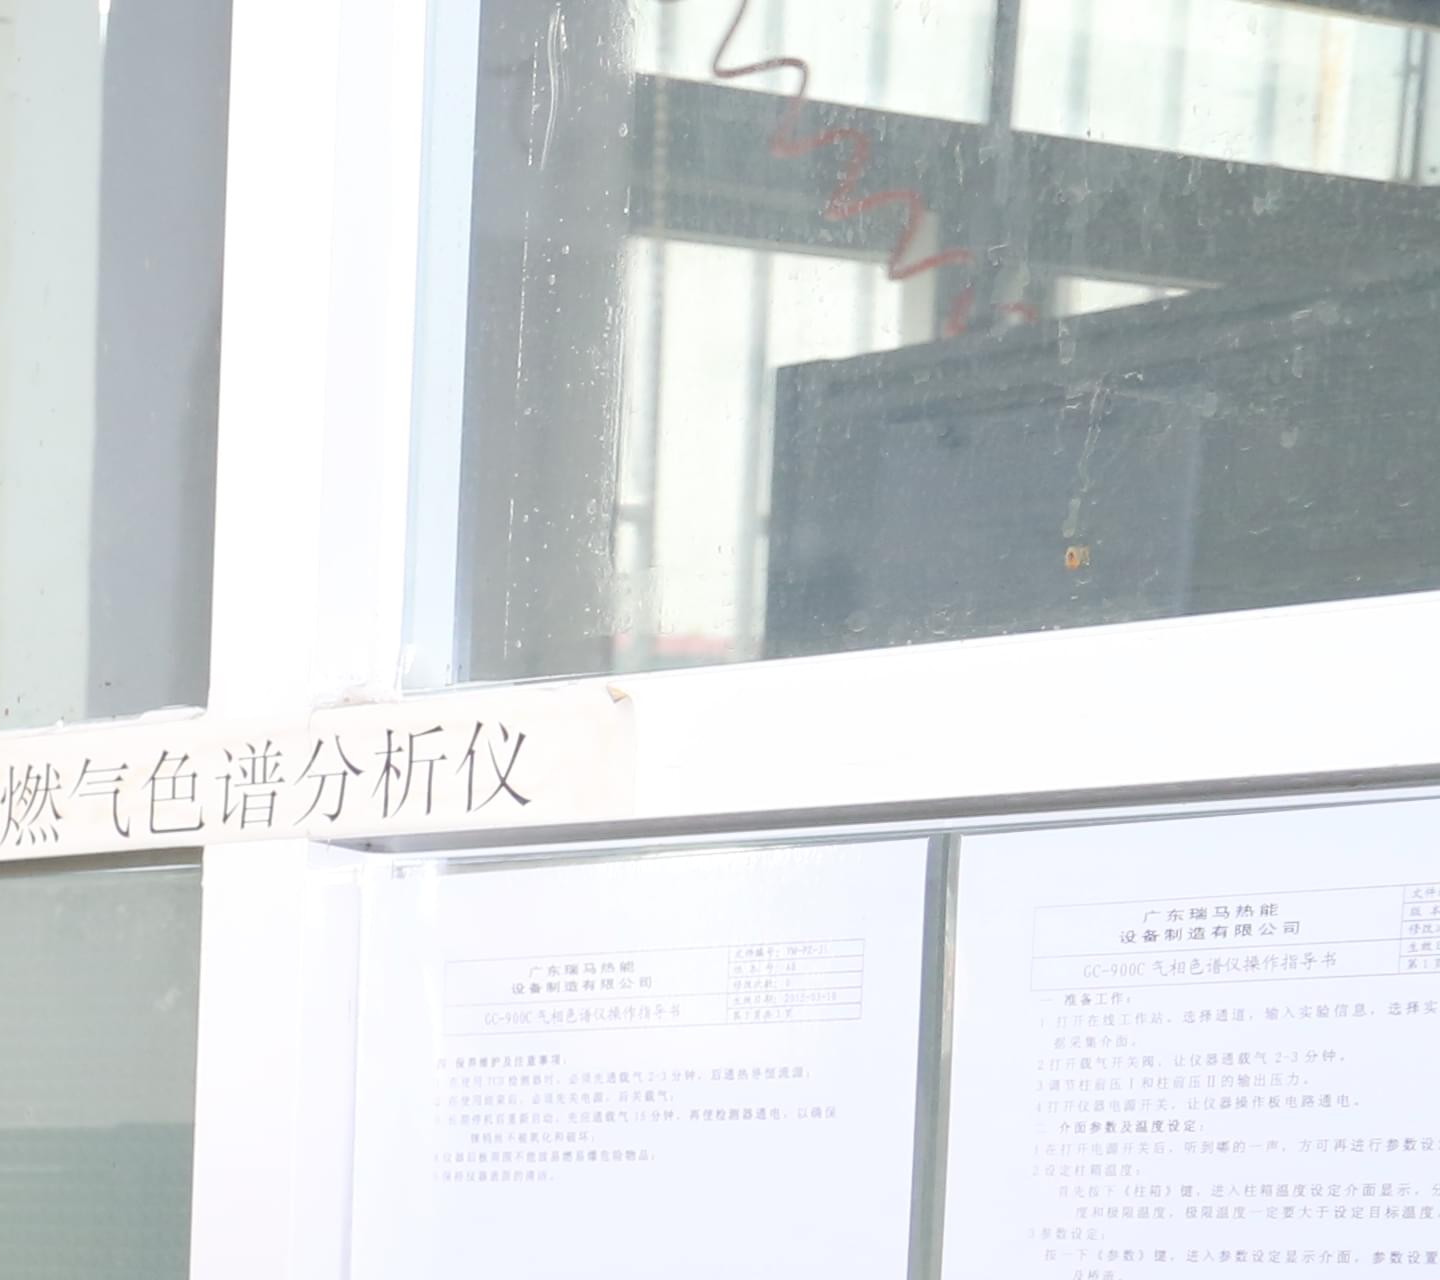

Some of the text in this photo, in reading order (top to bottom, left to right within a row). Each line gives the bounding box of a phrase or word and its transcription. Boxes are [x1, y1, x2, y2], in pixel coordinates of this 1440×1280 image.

[0, 720, 532, 847] 燃气色谱分析仪
[1120, 920, 1302, 943] 设备制造有限公司
[512, 976, 652, 995] 设备制造有限公司
